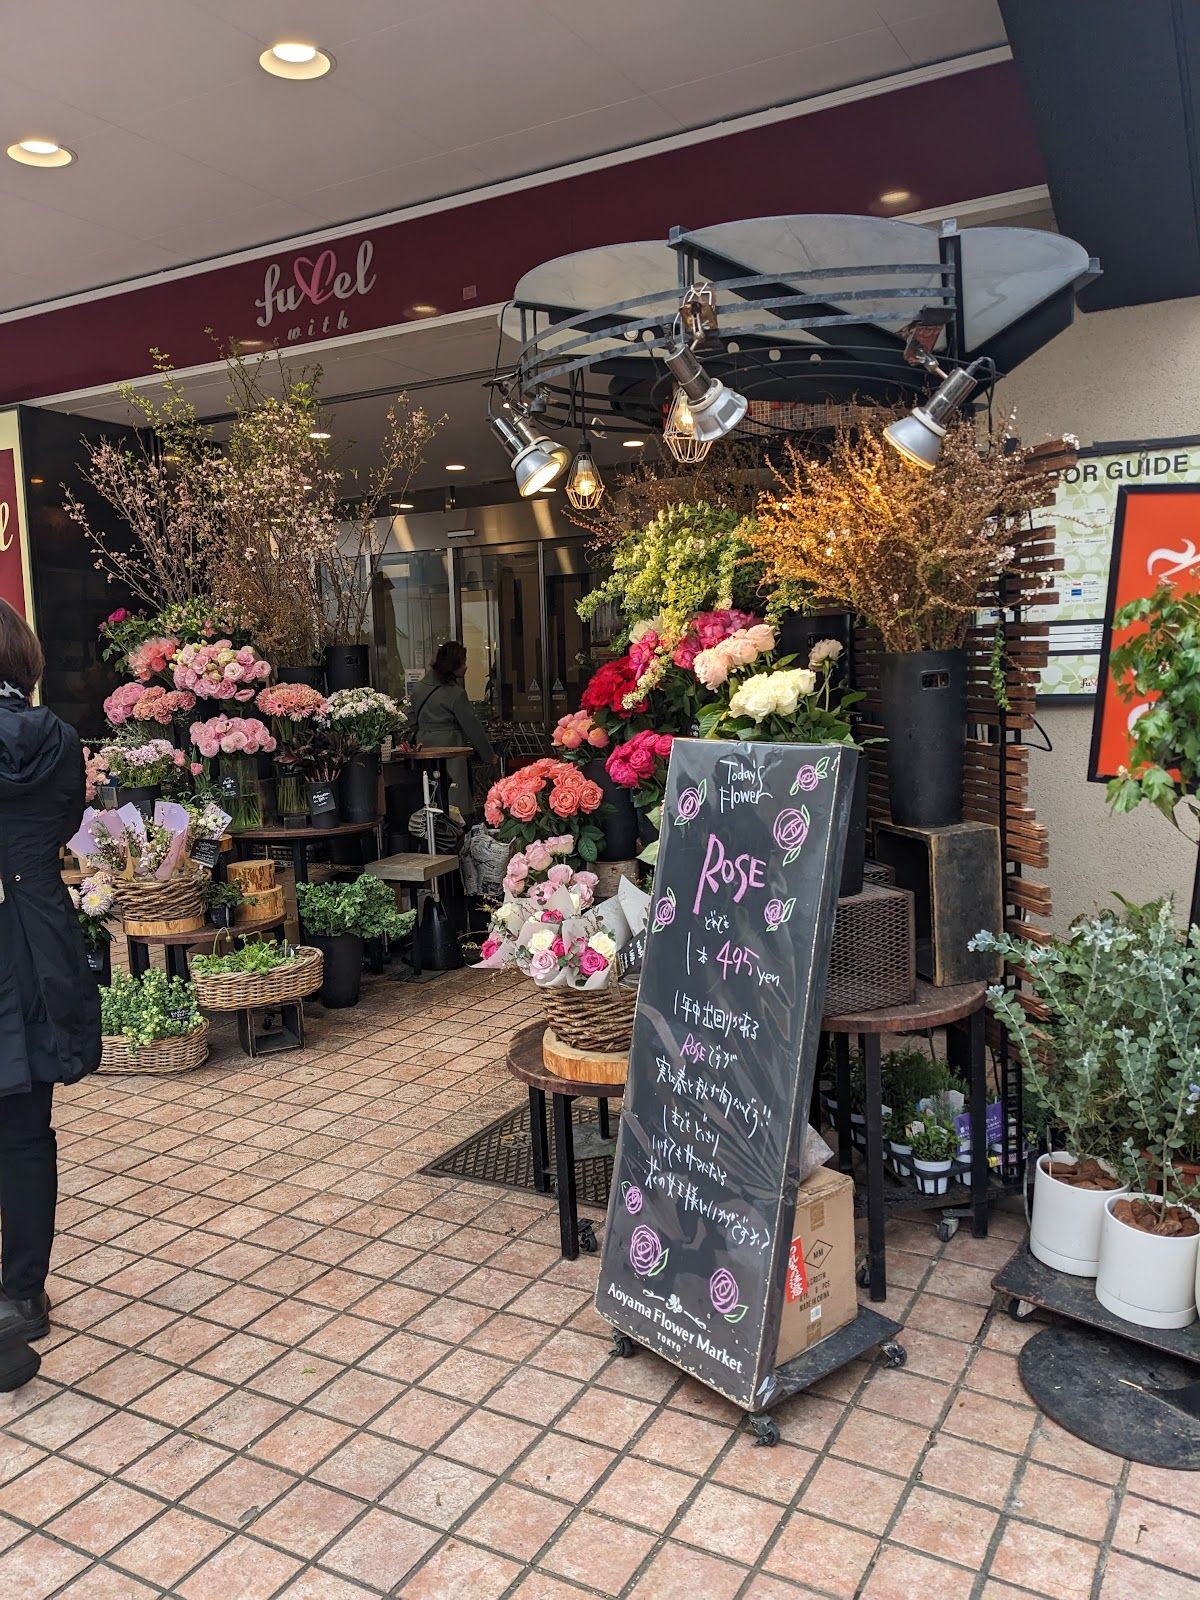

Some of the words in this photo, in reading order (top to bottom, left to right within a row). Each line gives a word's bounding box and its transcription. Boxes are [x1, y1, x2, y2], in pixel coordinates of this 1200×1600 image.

[287, 310, 349, 341] with
[1106, 454, 1188, 480] GUIDE
[719, 760, 765, 793] Today's
[719, 785, 773, 813] Flower
[692, 833, 767, 915] ROSE
[704, 910, 730, 934] どれでも
[716, 939, 759, 980] 495
[757, 965, 780, 986] yen
[608, 1282, 651, 1319] Aoyama
[653, 1308, 695, 1344] Flower
[696, 1334, 742, 1374] Market
[657, 1332, 681, 1352] TOKYO
